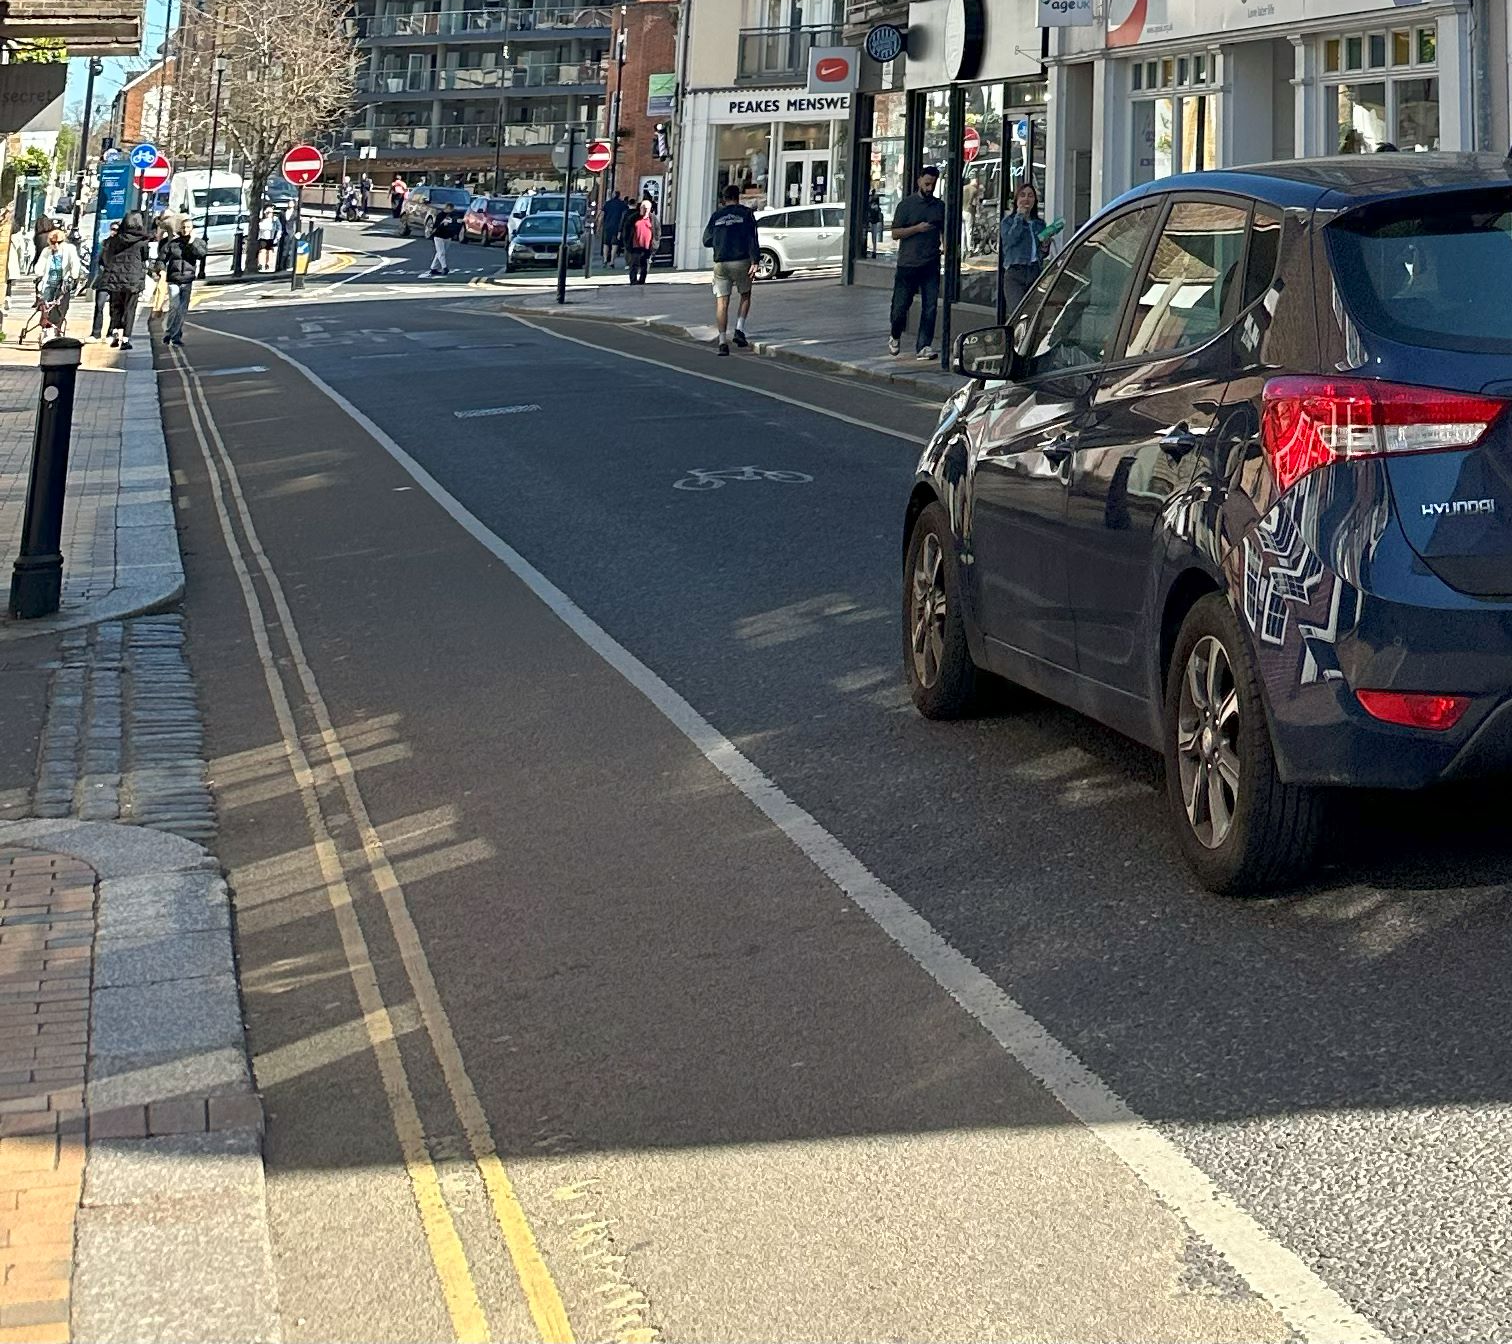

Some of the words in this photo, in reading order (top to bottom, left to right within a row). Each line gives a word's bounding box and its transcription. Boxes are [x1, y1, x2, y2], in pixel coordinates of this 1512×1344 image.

[729, 100, 780, 113] PEAKES
[787, 96, 850, 111] MENSWE
[1422, 499, 1495, 516] HYUNDAI
